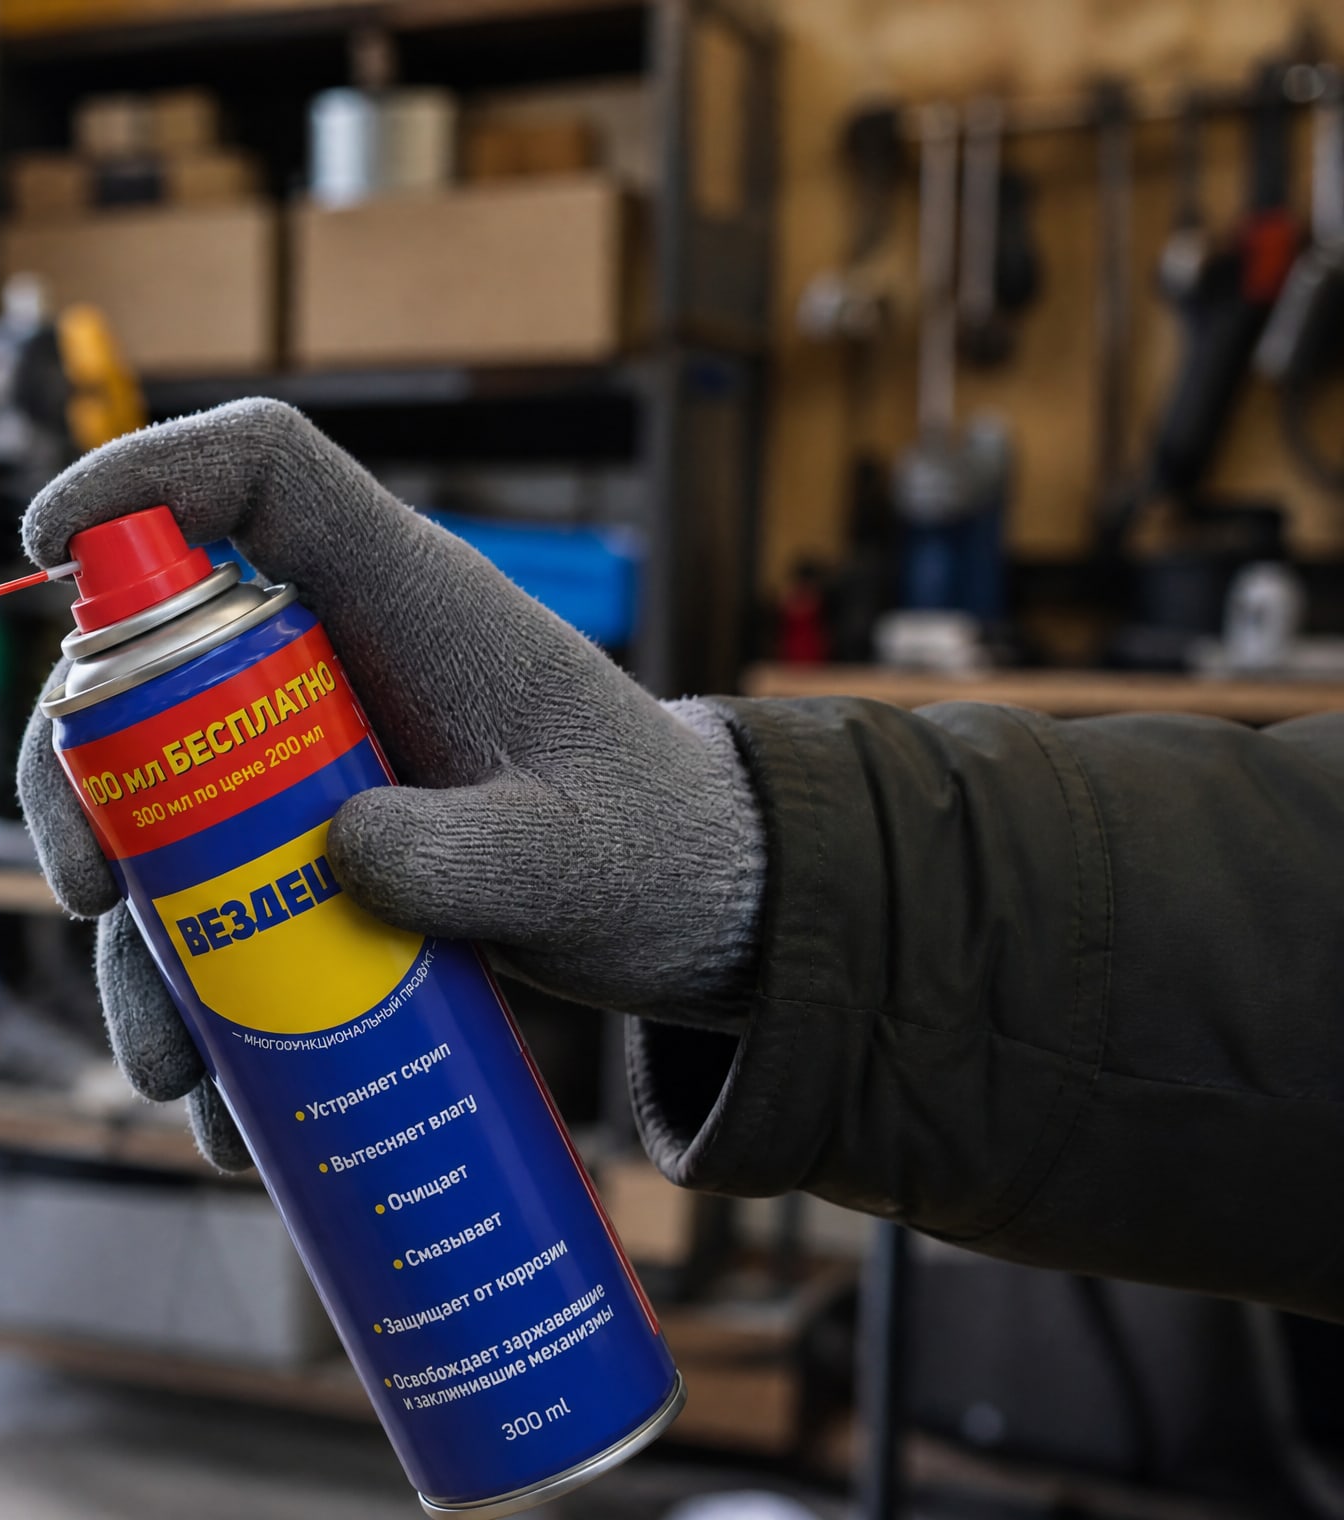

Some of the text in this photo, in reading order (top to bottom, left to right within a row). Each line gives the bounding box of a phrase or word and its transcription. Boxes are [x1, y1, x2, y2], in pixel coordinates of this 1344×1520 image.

[82, 661, 336, 805] 100 мл БЕСПЛАТНО
[132, 725, 326, 828] 300 мл по цене 200 мл
[306, 1043, 451, 1120] Устраняет скрип
[330, 1094, 478, 1172] Вытесняет влагу
[387, 1164, 469, 1211] Очищает
[405, 1211, 503, 1266] Смазывает
[382, 1240, 568, 1335] Защищает от коррозии
[392, 1284, 606, 1390] Освобождает заржавевшие
[402, 1304, 615, 1411] и заклинившие механизмы
[501, 1397, 571, 1442] 300 ml
